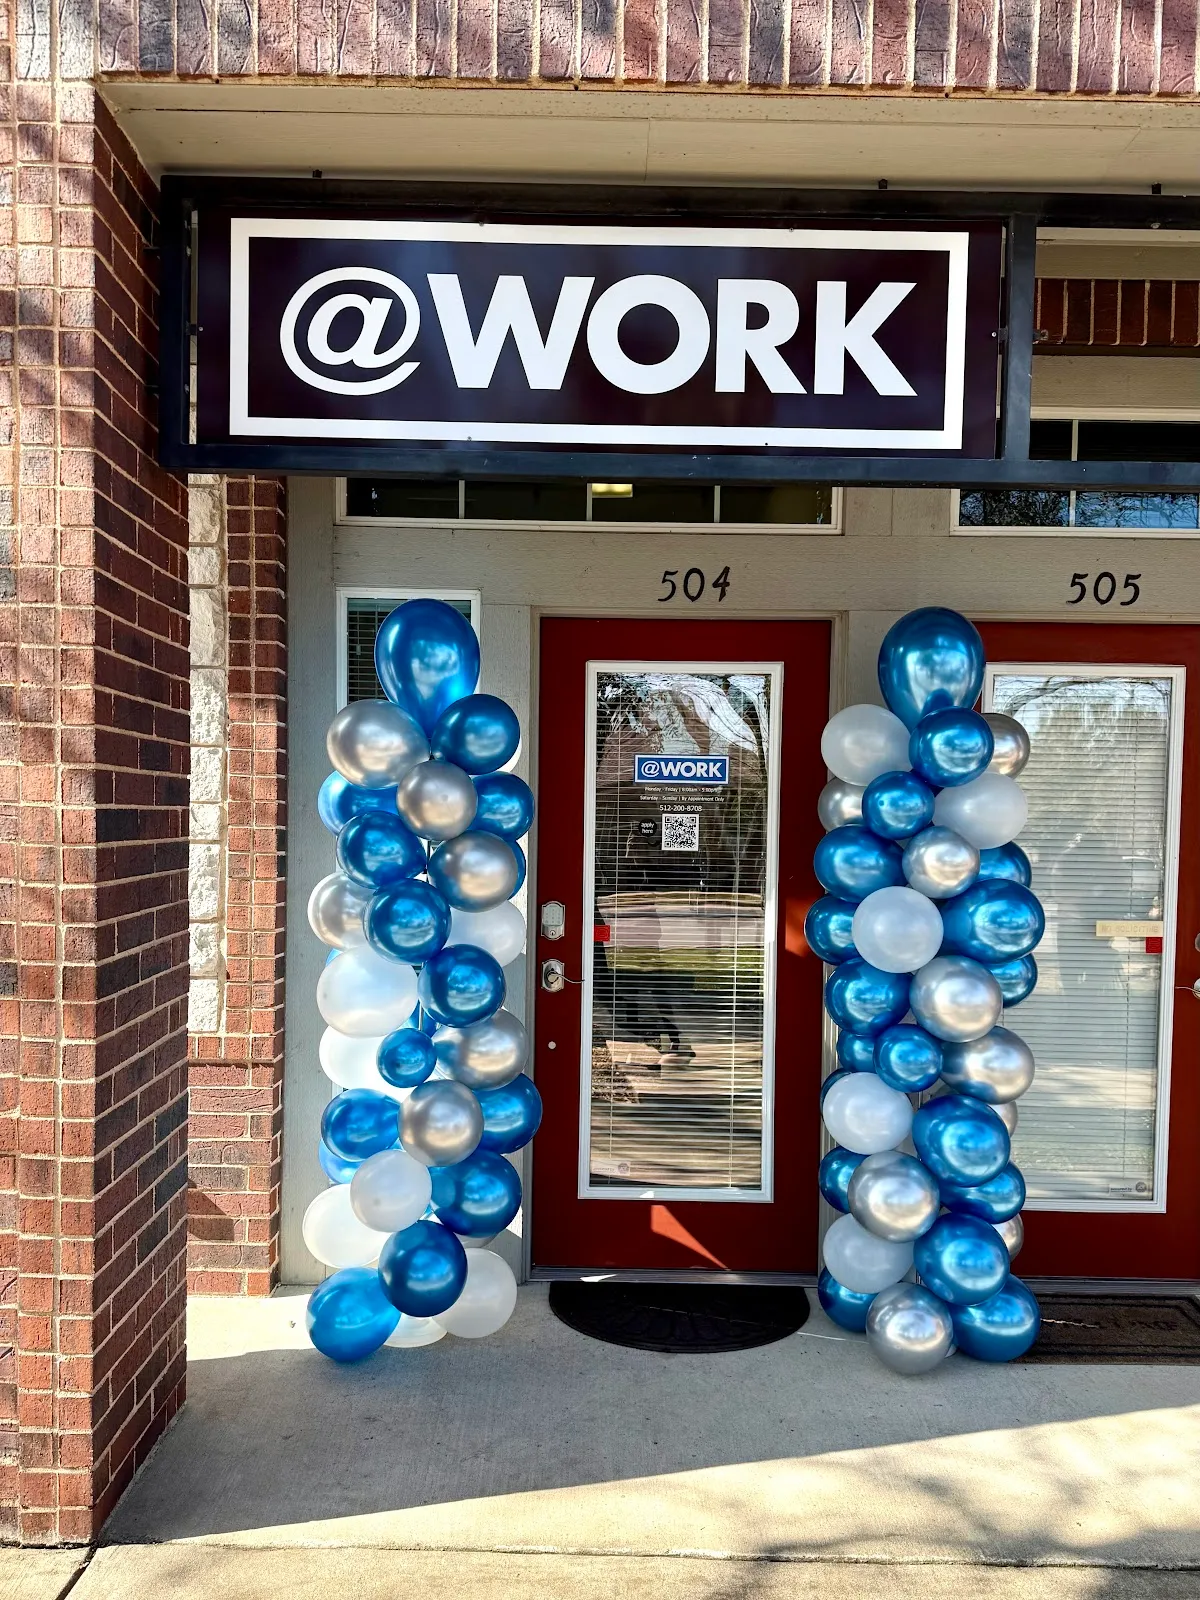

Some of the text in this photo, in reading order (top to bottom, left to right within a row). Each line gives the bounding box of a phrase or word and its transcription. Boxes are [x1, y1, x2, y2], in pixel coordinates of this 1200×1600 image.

[279, 266, 918, 397] @WORK
[657, 566, 731, 603] 504
[1065, 571, 1142, 606] 505
[641, 760, 723, 778] @WORK
[659, 804, 703, 812] 512-200-8708
